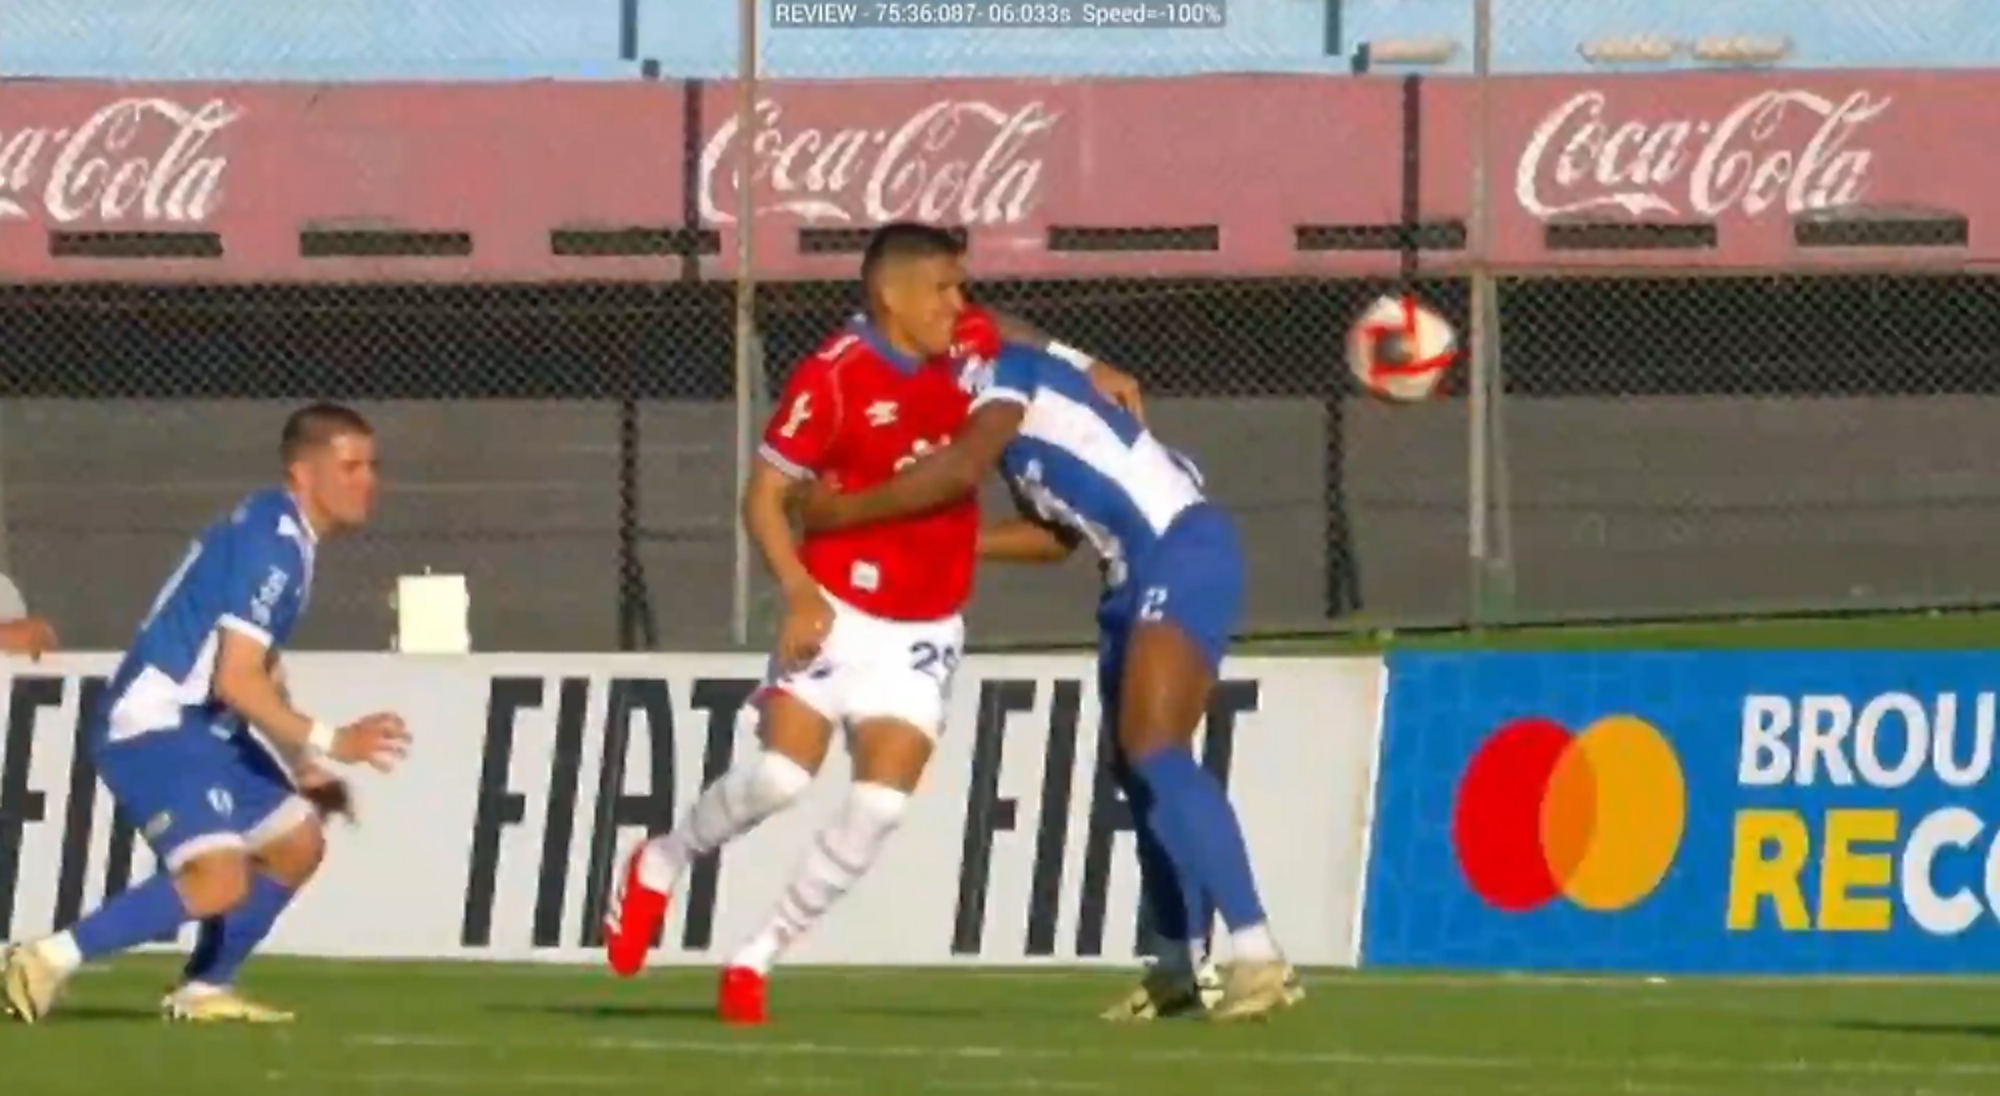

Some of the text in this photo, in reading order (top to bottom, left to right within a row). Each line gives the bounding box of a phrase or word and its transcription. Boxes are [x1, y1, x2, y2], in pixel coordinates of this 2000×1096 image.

[0, 97, 242, 222] a-Cola
[699, 98, 1062, 222] Coca-Cola
[1514, 90, 1891, 218] Coca-Cola
[1738, 691, 1996, 788] BROU
[0, 676, 137, 939] FI
[461, 677, 762, 948] FIAT
[1726, 806, 2000, 934] REC
